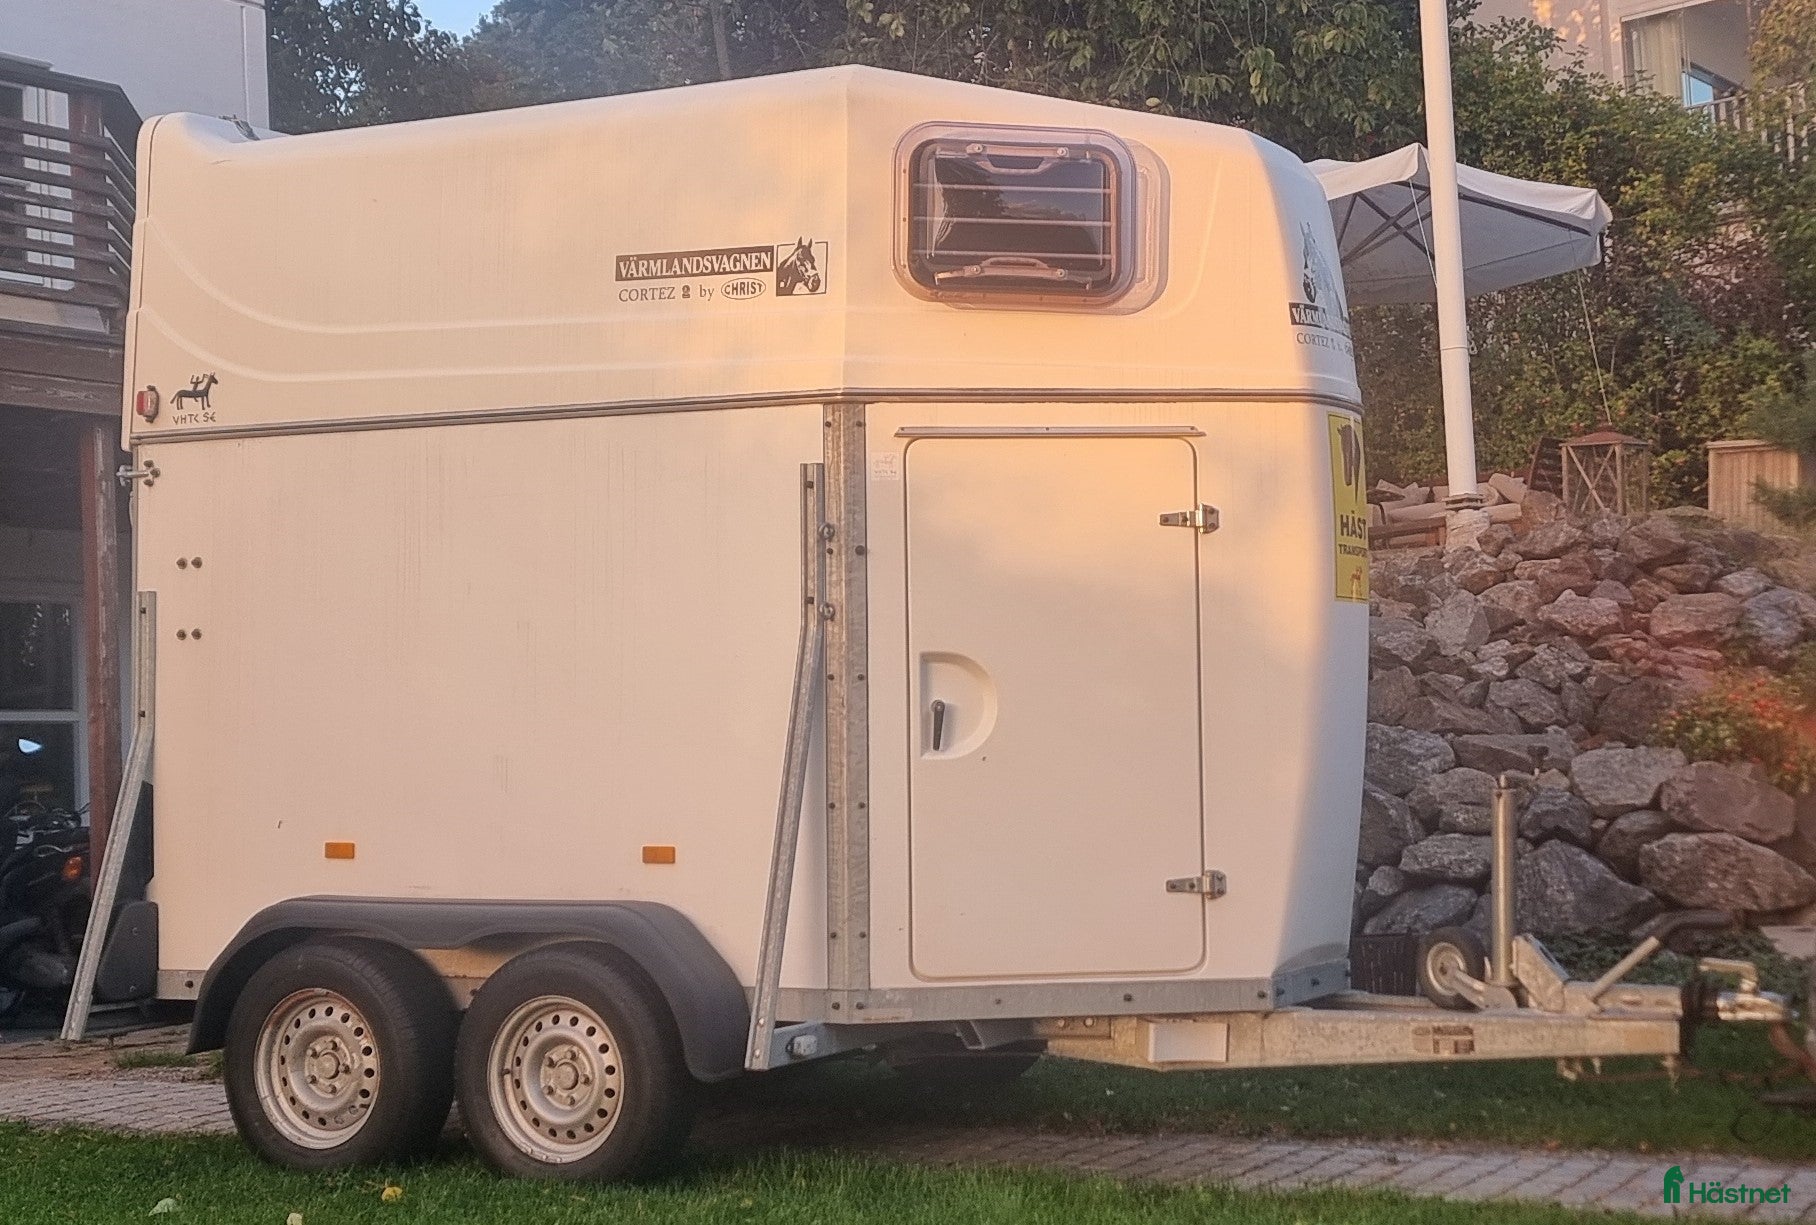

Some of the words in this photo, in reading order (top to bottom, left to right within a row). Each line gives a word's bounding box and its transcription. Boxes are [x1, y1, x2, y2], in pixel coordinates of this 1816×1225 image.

[618, 251, 772, 279] VÄRMLANDSVAGNEN
[618, 286, 676, 302] CORTEZ
[699, 284, 715, 302] by
[724, 281, 763, 296] CHRIST
